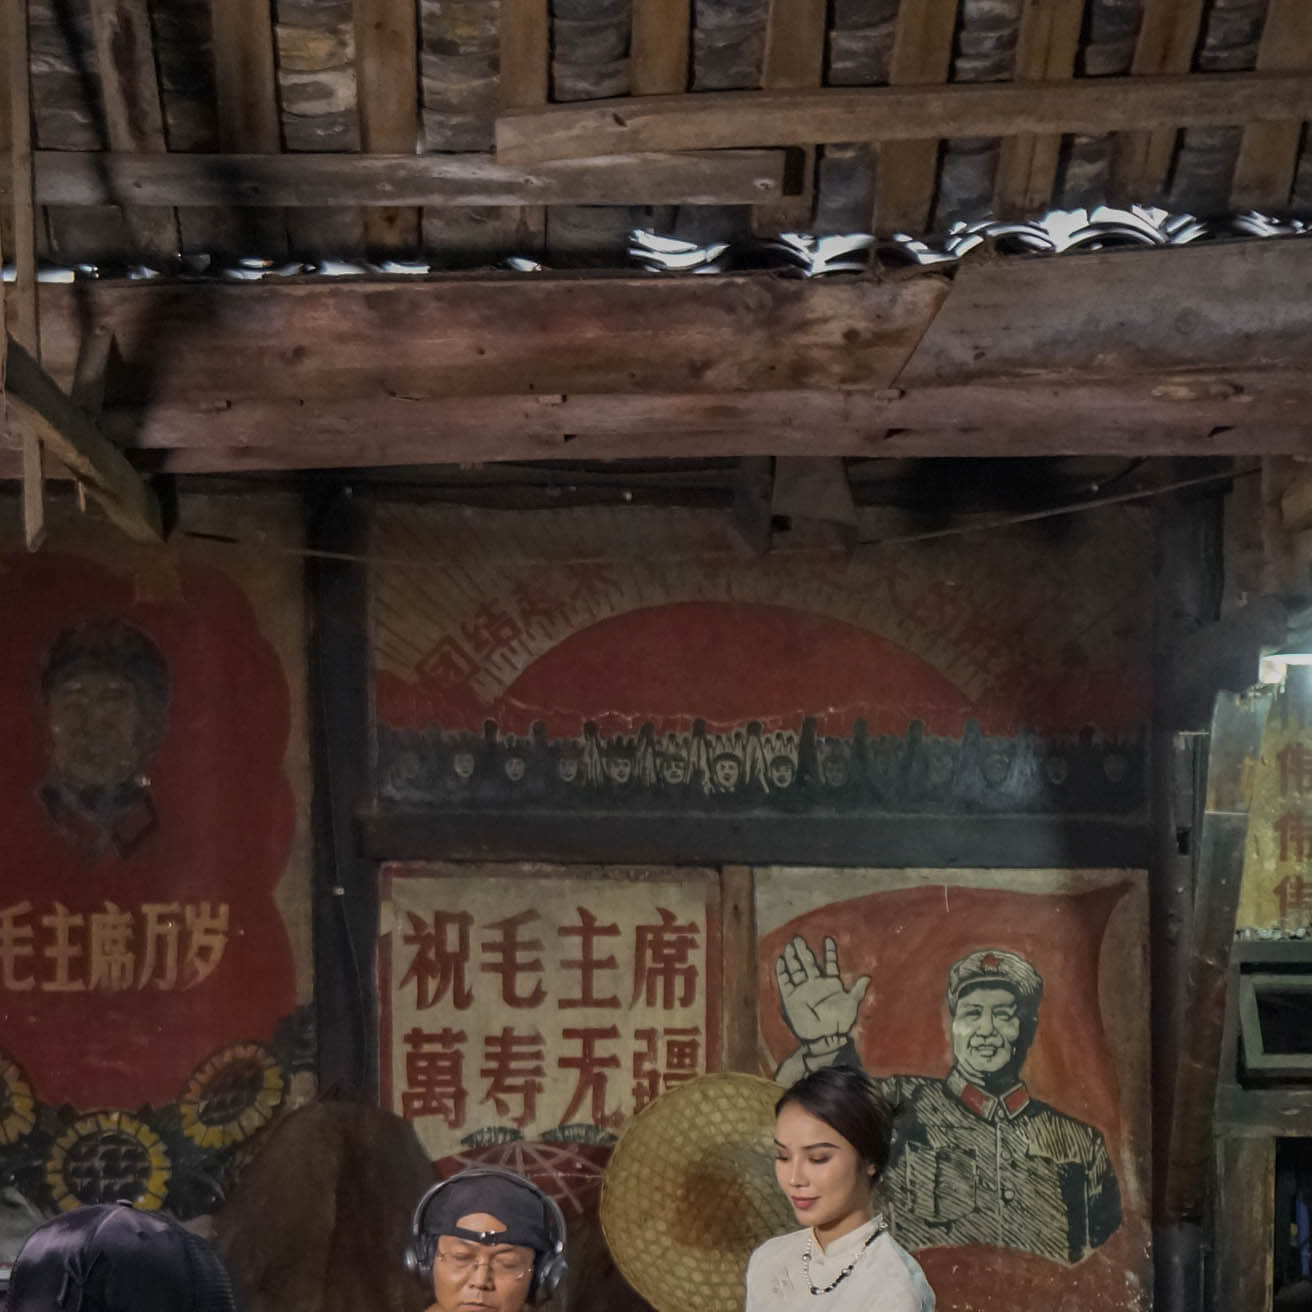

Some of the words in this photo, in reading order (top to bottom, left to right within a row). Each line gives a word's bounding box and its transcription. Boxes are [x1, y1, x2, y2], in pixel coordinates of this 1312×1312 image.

[398, 906, 702, 1014] 祝毛主席
[399, 1024, 702, 1131] 萬寿无疆
